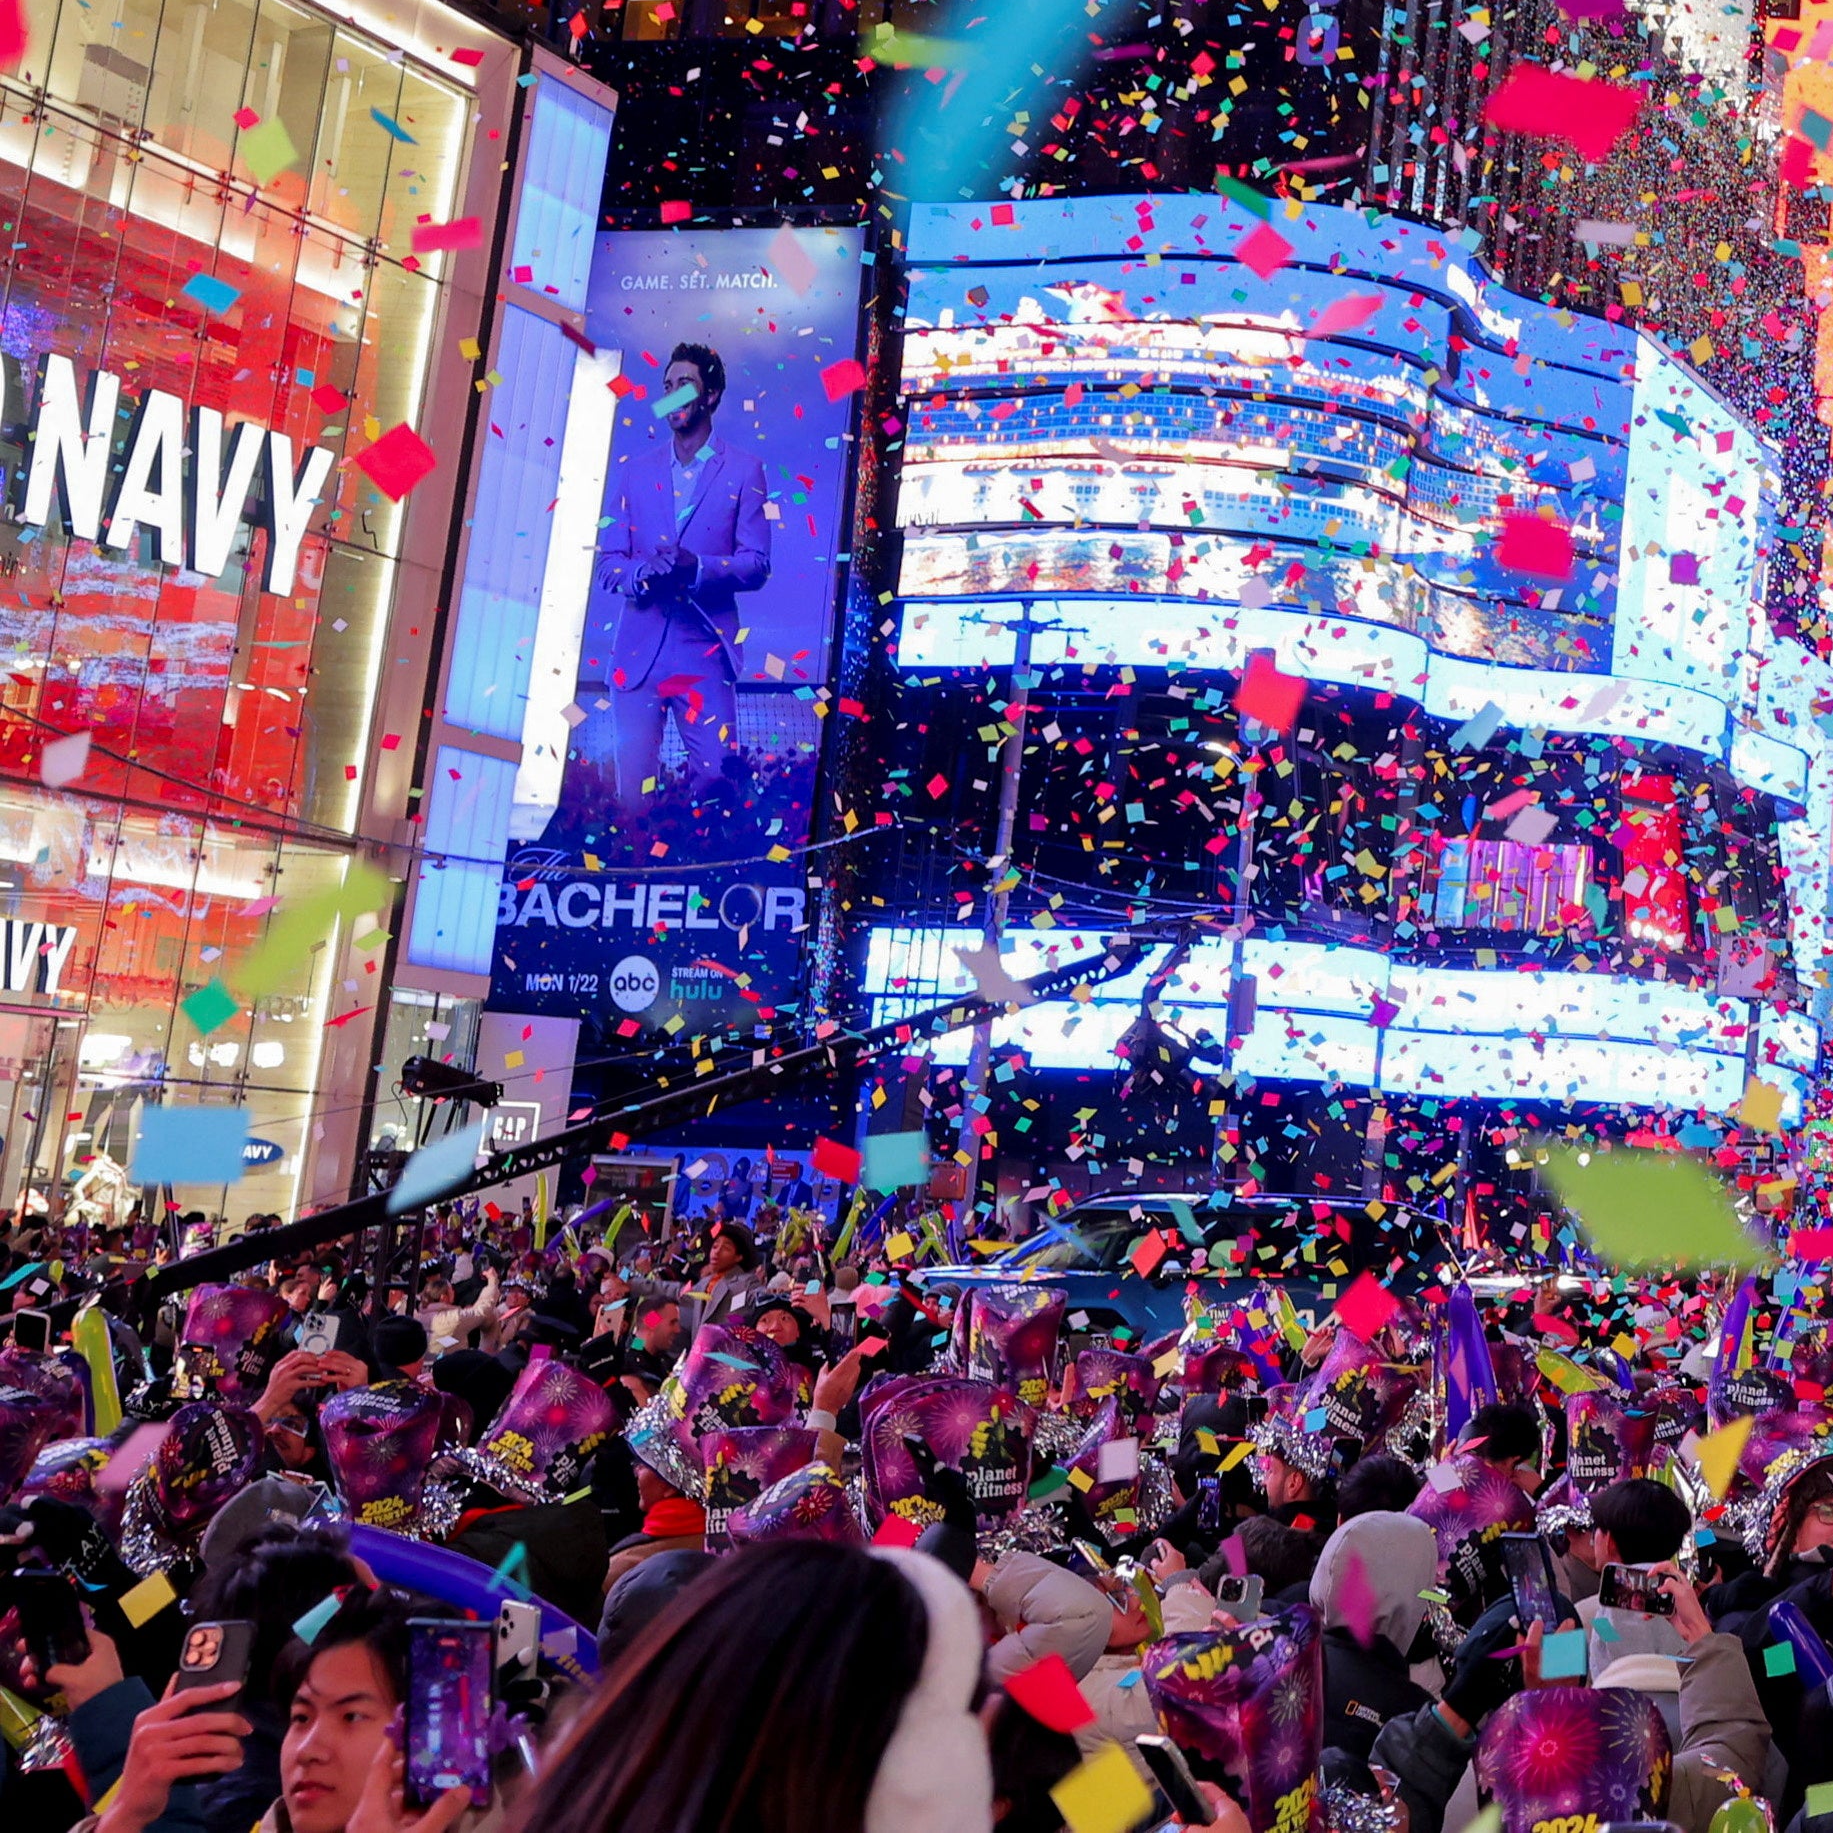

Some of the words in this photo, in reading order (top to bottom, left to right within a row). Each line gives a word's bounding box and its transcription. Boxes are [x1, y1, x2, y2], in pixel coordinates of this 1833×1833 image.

[621, 275, 674, 291] GAME.
[679, 274, 710, 290] SET.
[716, 273, 778, 289] MATCH.
[24, 353, 335, 598] NAVY
[496, 882, 806, 932] BACHELOR
[0, 918, 76, 994] VY
[613, 972, 656, 992] abc
[671, 966, 705, 979] STREAM
[525, 973, 564, 992] MON
[568, 974, 599, 993] 1/22
[669, 979, 723, 1001] hulu
[493, 1115, 526, 1142] GAP
[242, 1144, 273, 1160] AVY
[1726, 1383, 1774, 1398] planet
[1731, 1392, 1780, 1407] fitness
[1320, 1395, 1364, 1428] planet
[211, 1408, 241, 1463] fitness
[203, 1424, 228, 1476] planet
[966, 1466, 1019, 1485] planet
[973, 1479, 1027, 1498] fitness
[363, 1498, 404, 1517] 2024
